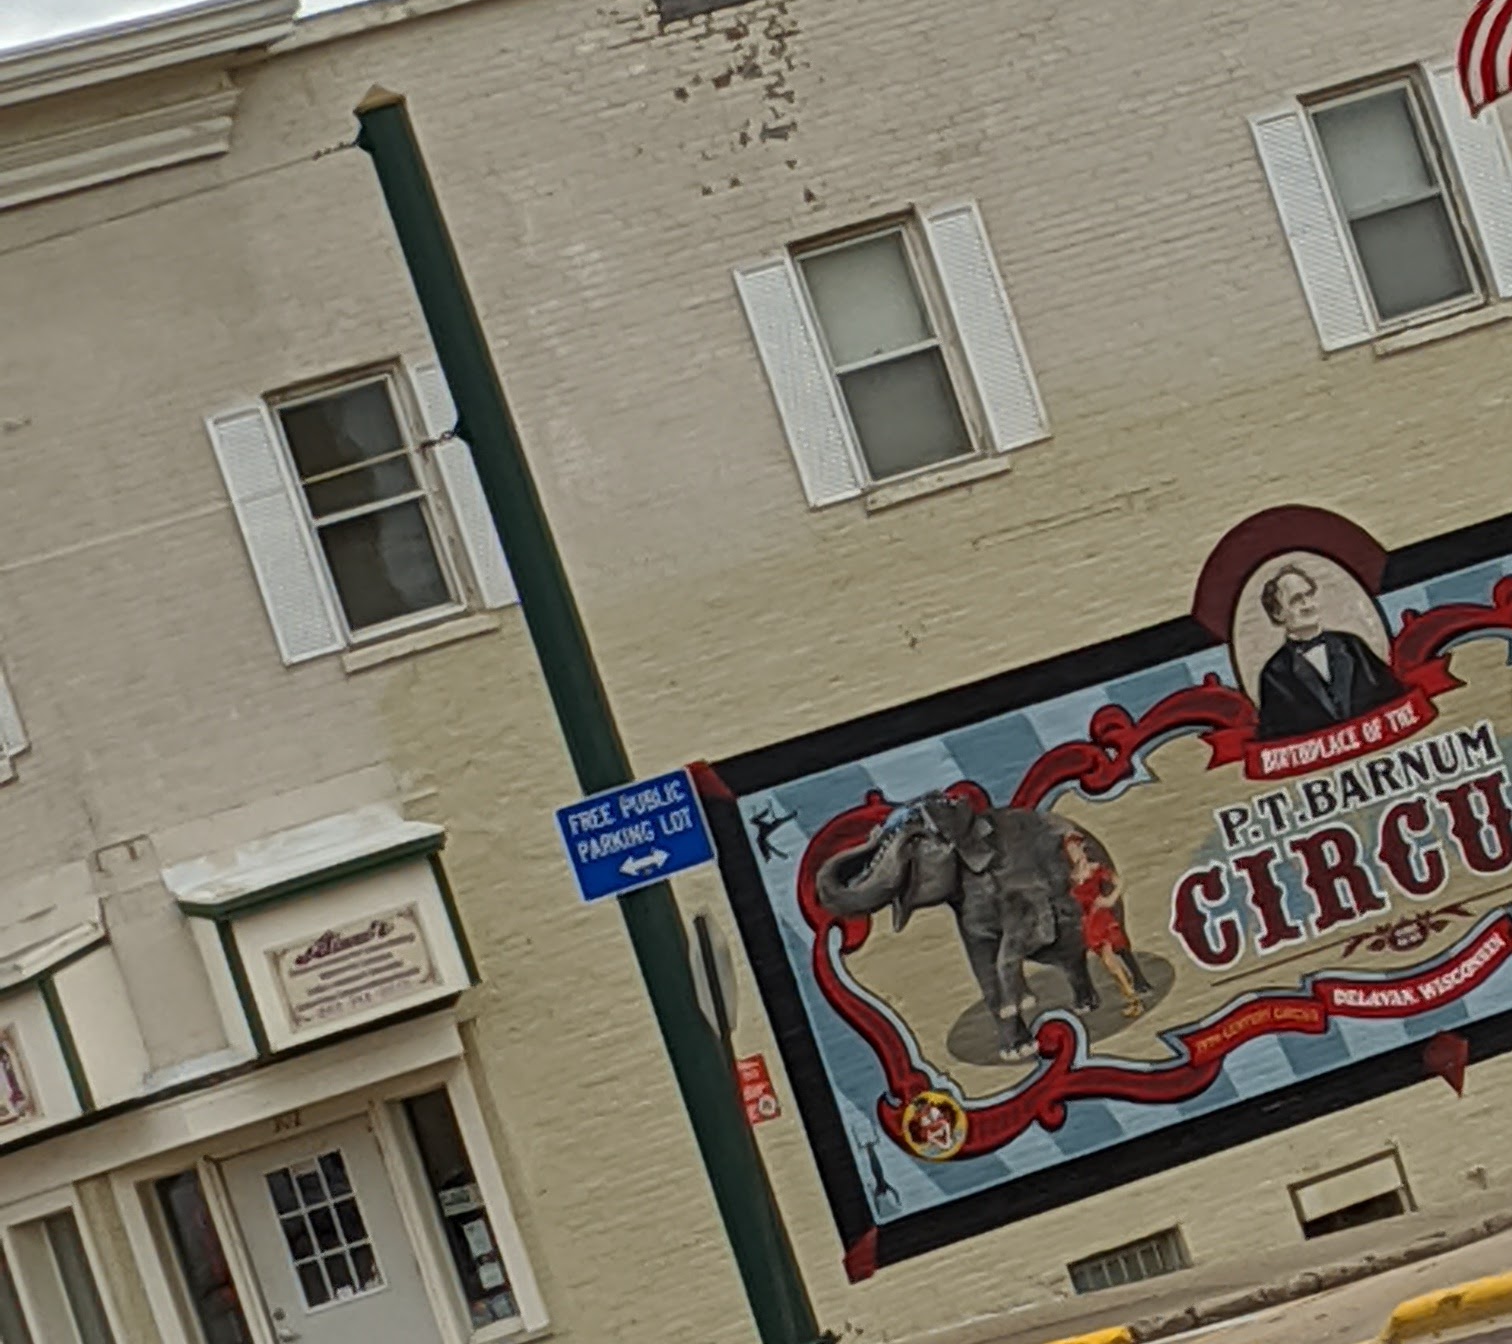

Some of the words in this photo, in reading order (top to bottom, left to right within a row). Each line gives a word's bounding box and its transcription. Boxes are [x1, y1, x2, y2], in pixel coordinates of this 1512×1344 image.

[1260, 726, 1362, 775] BIRTHPLACE
[1362, 716, 1383, 743] OF
[1385, 700, 1421, 733] THE
[567, 801, 617, 836] FREE
[619, 778, 687, 819] PUBLIC
[576, 819, 656, 864] PARKING
[659, 804, 694, 836] LOT
[1418, 931, 1507, 1001] WISCONSIN
